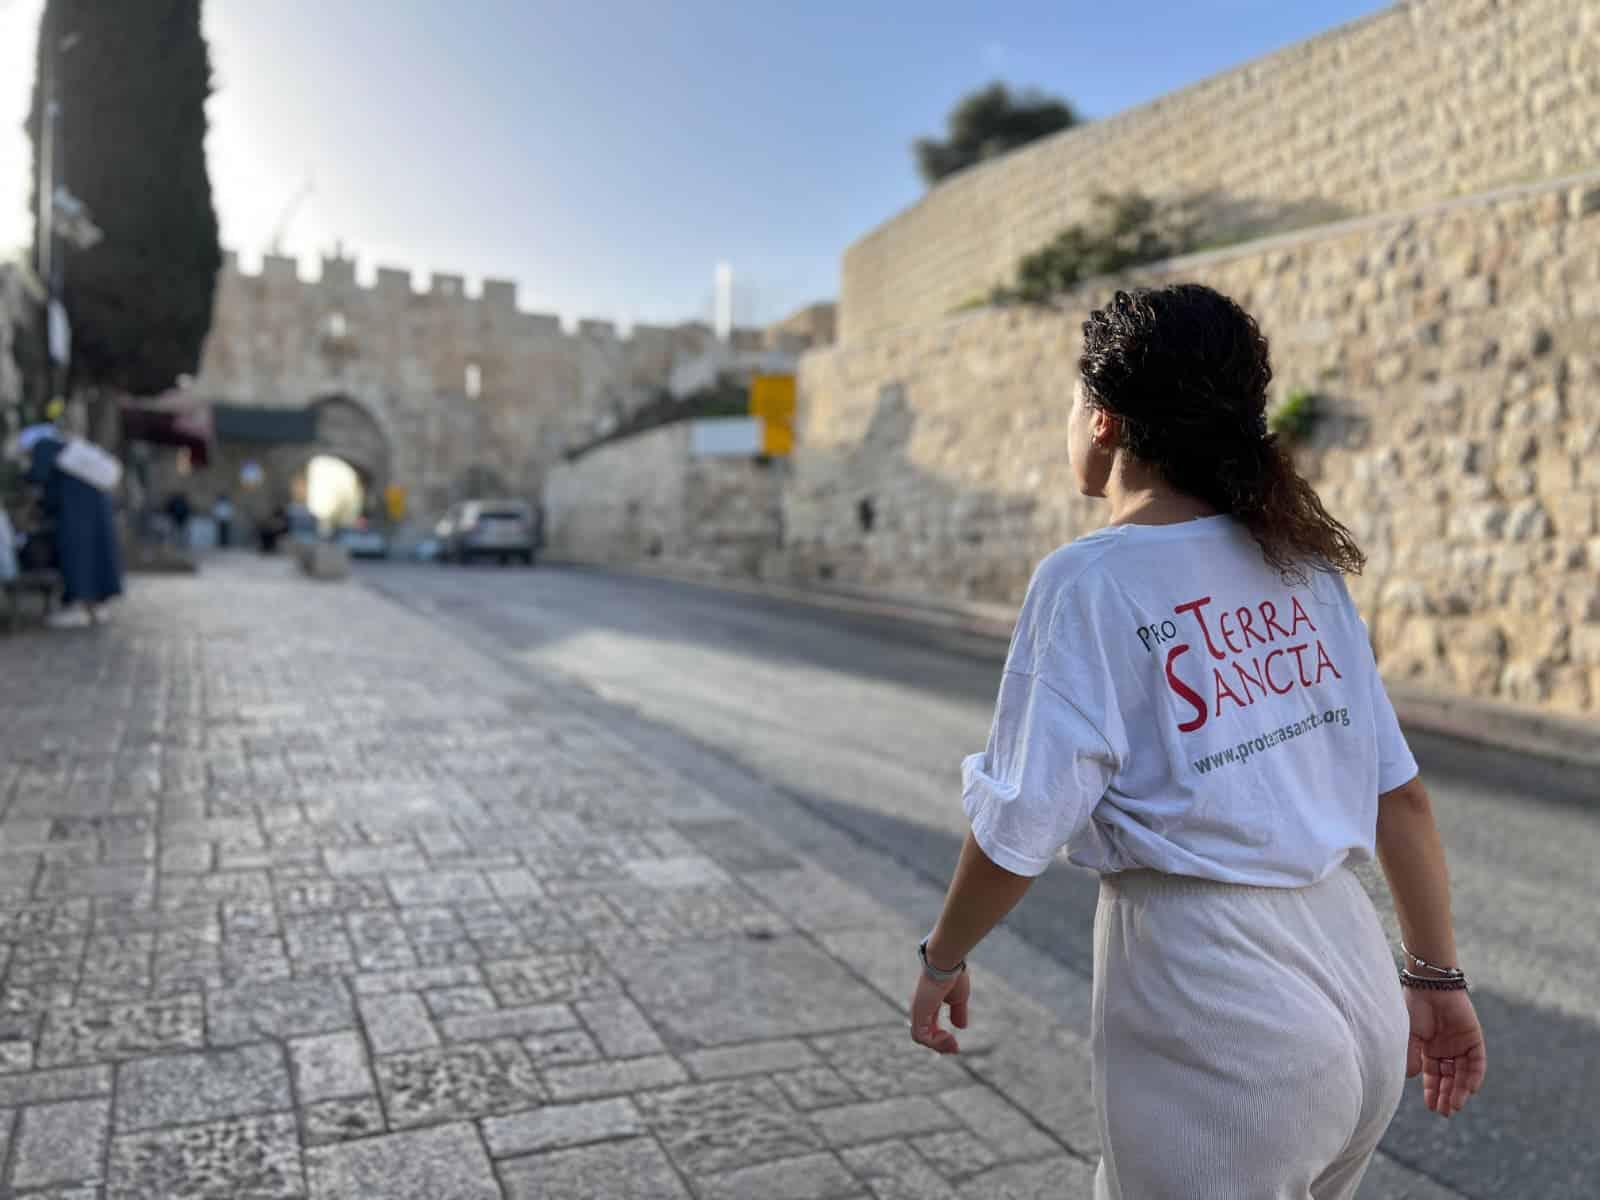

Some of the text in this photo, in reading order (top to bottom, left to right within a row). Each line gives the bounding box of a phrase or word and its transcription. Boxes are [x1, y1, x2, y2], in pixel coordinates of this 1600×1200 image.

[1136, 596, 1316, 660] PRO TERRA
[1165, 640, 1342, 733] SANCTA
